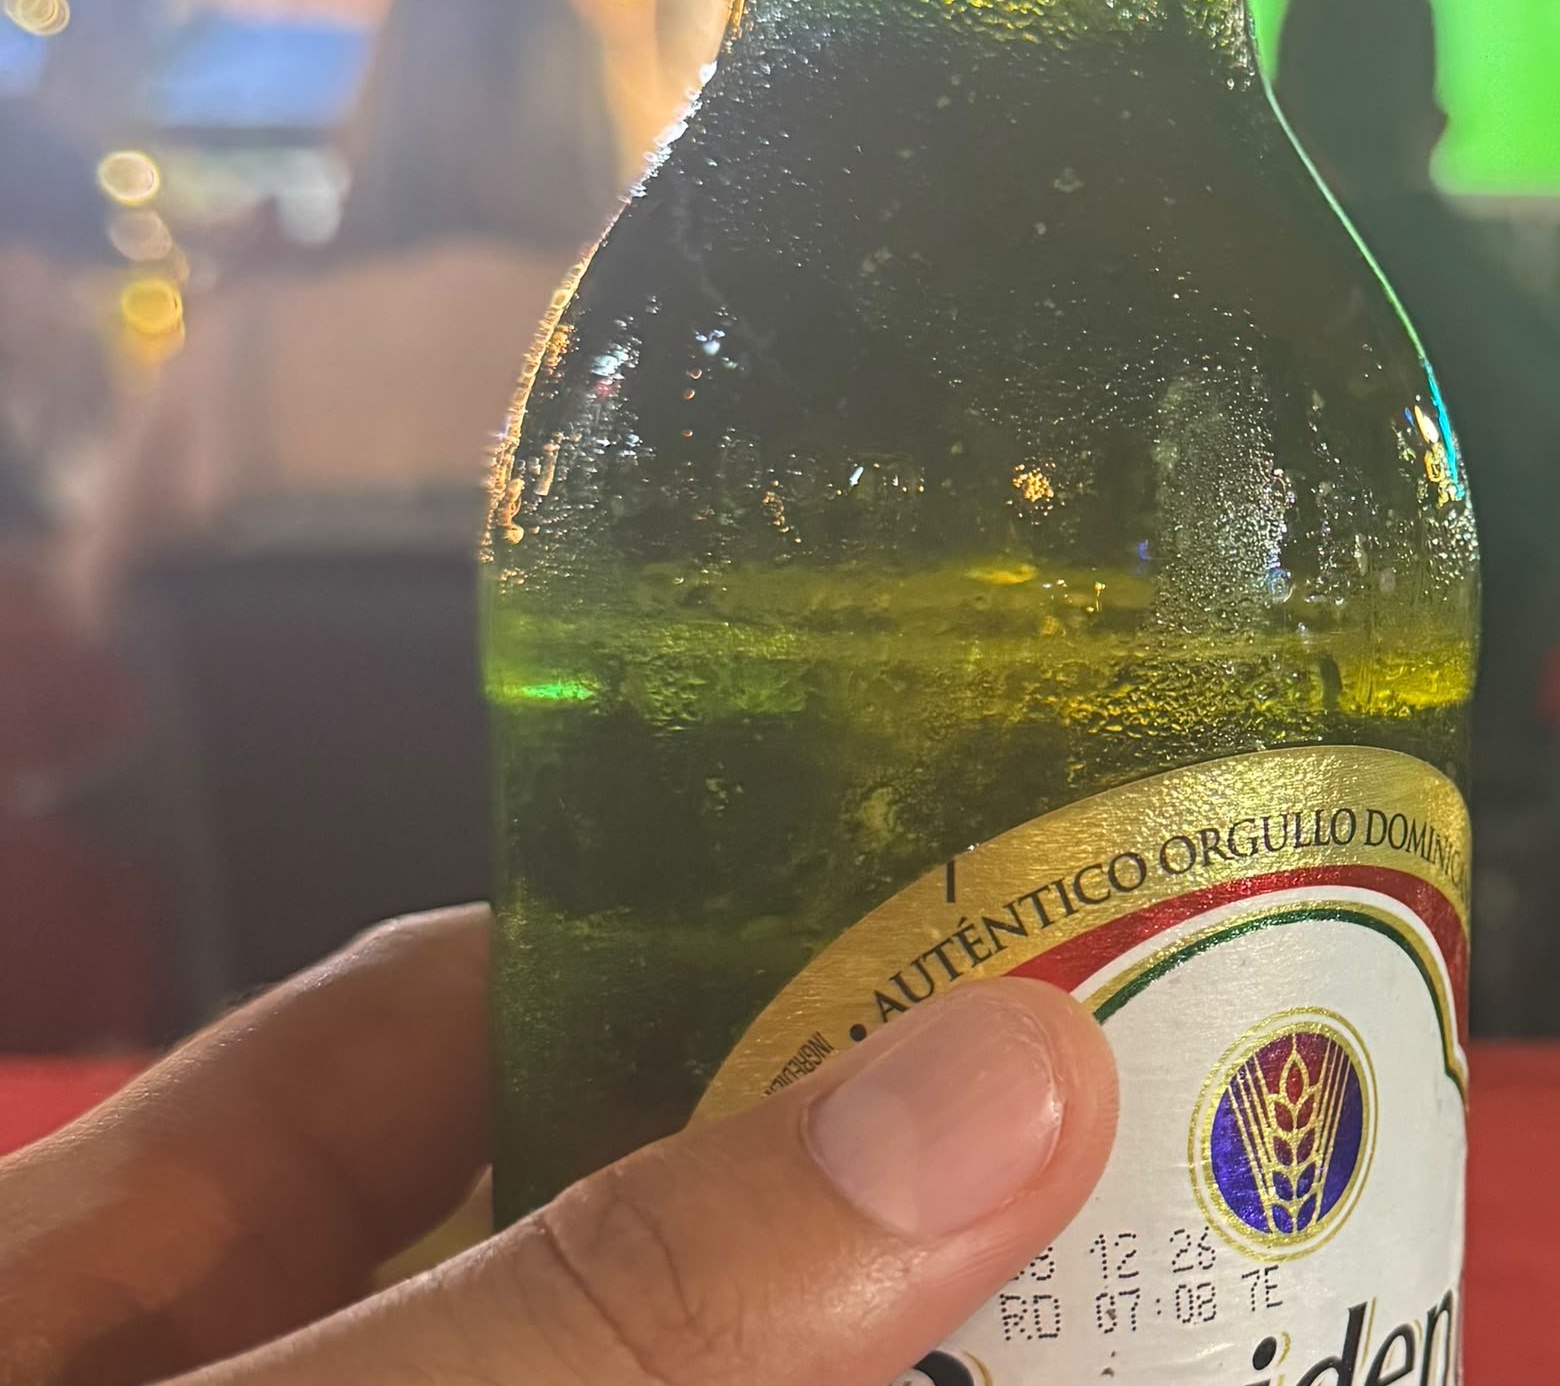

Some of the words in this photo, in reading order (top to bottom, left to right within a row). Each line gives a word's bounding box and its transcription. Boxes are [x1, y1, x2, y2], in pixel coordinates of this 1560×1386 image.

[873, 852, 1147, 1023] AUTÉNTICO
[1159, 808, 1356, 875] ORGULLO
[1089, 1233, 1140, 1280] 12
[1169, 1226, 1217, 1273] 26
[999, 1294, 1061, 1342] RD
[1095, 1282, 1217, 1334] 07:08
